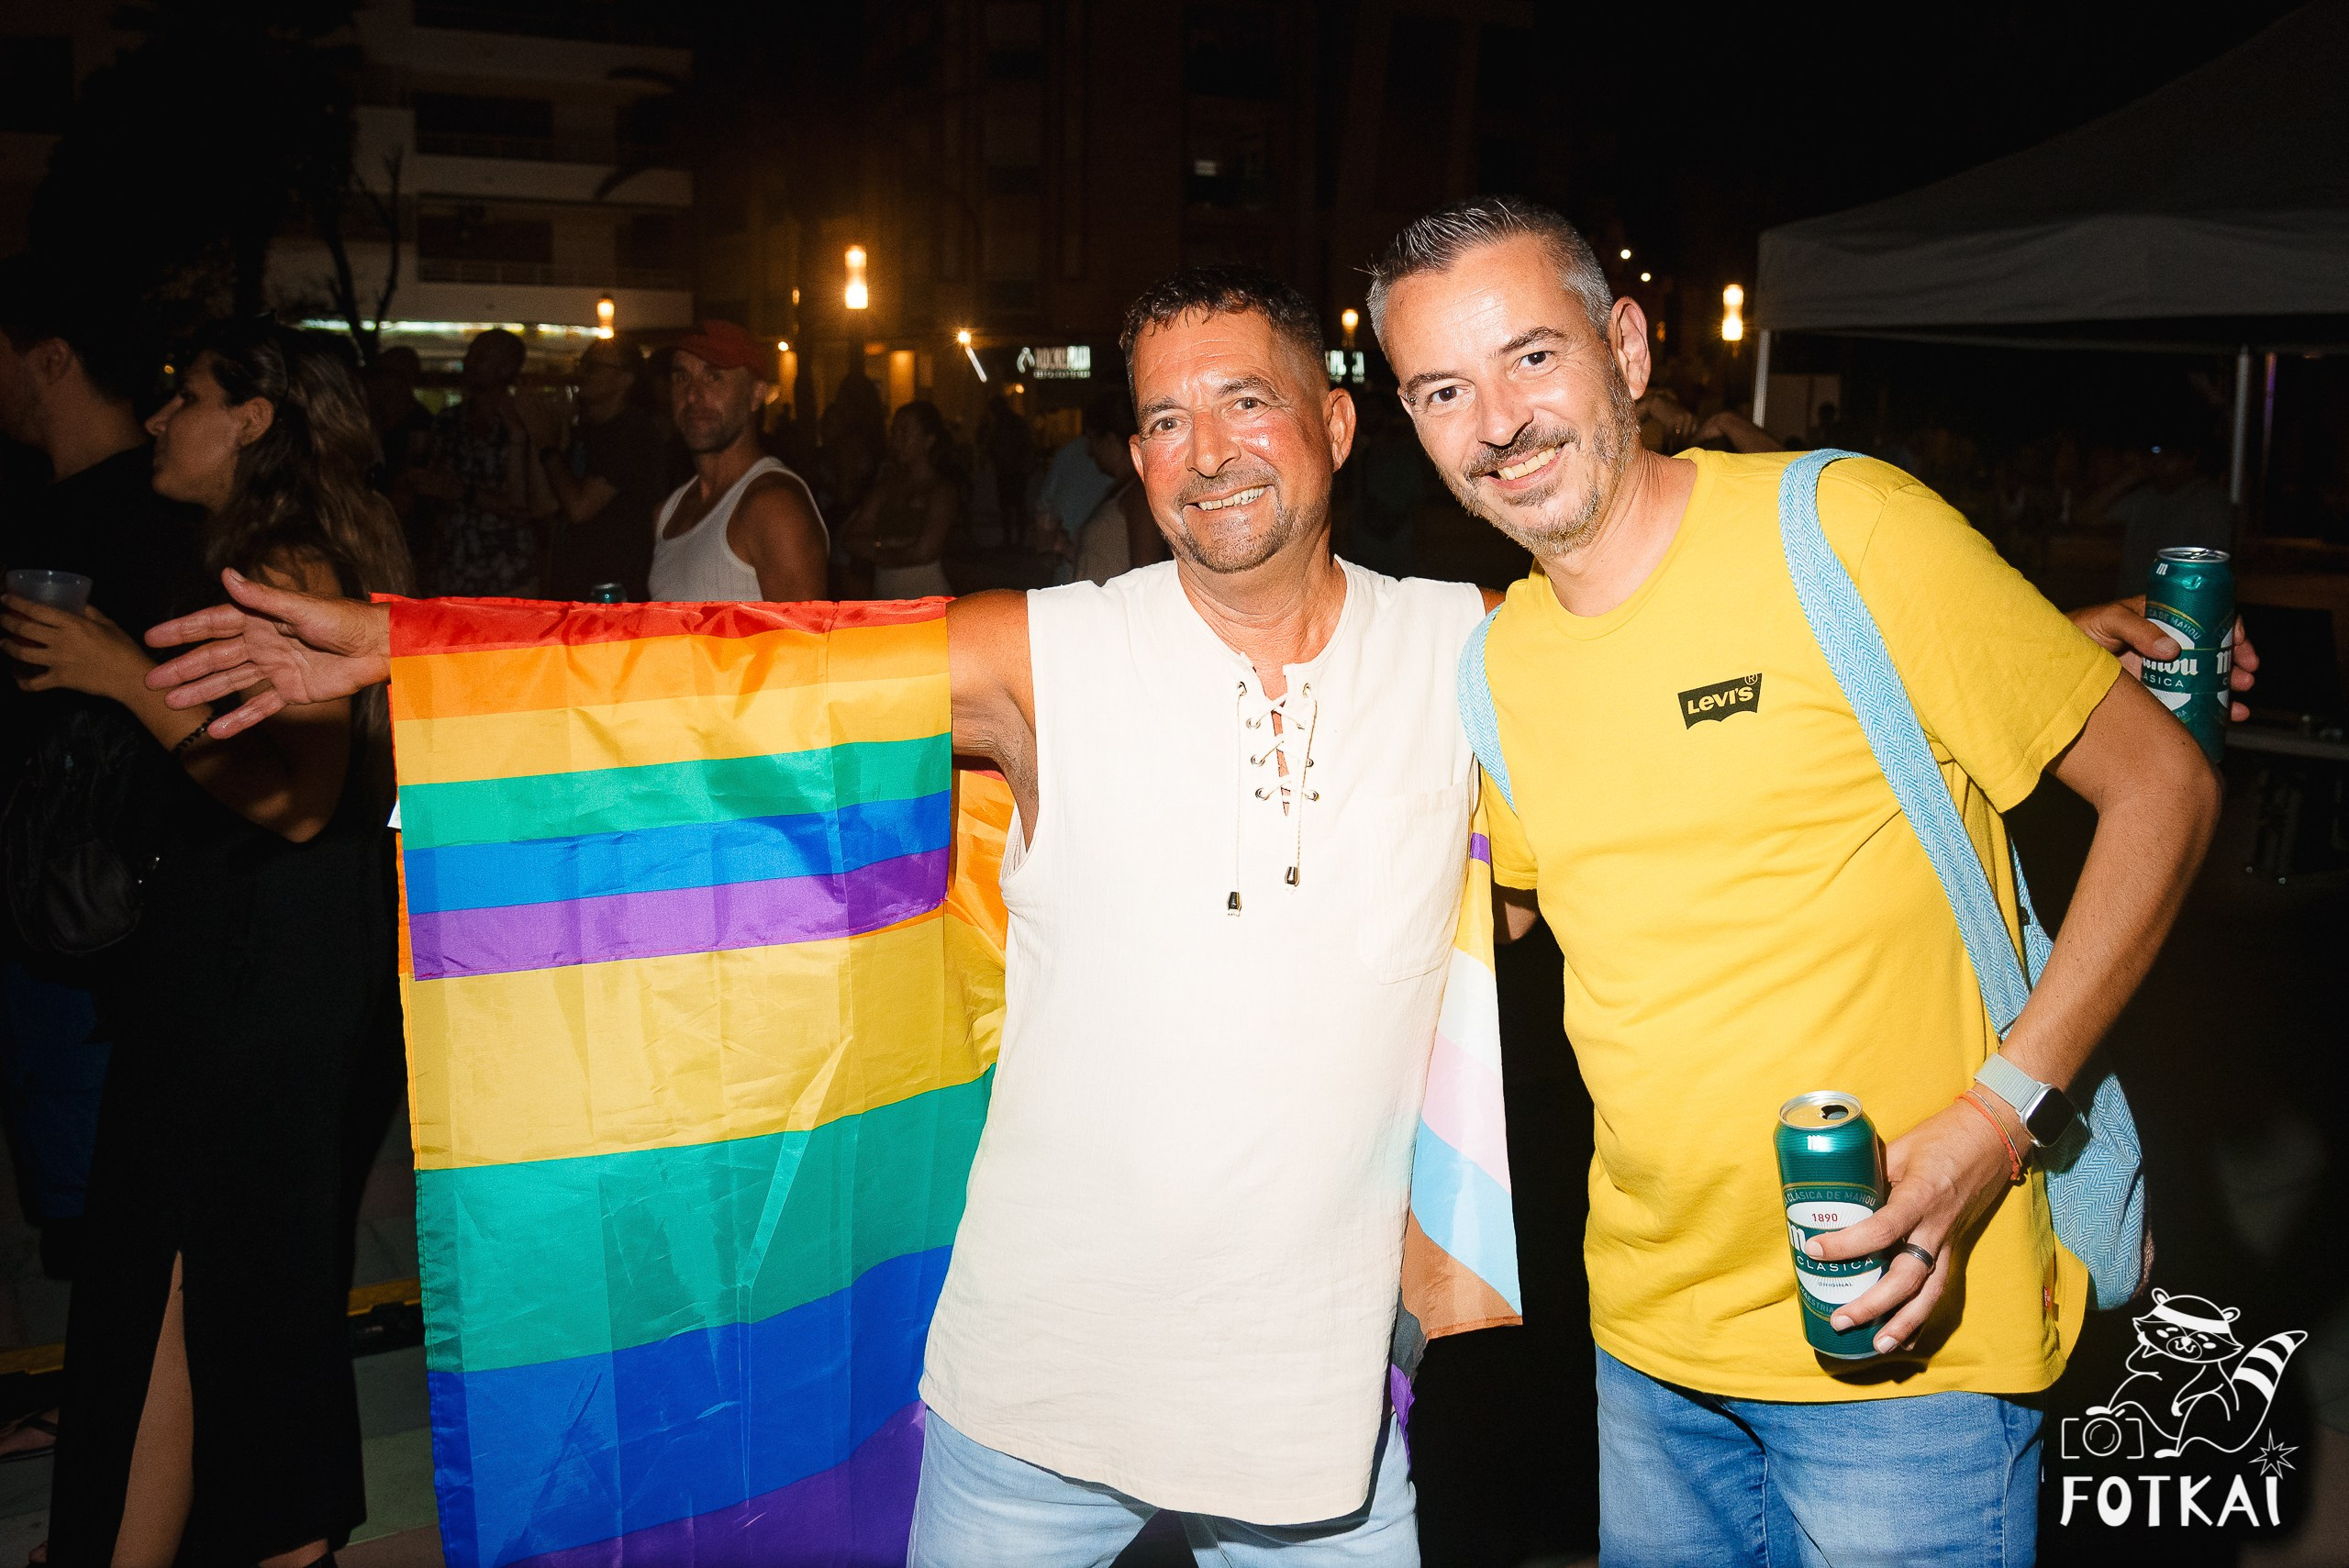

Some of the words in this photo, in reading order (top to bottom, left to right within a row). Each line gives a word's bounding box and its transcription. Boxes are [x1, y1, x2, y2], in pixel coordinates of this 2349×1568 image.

[2170, 616, 2201, 639] MAHOU
[1826, 1191, 1841, 1200] DE
[1844, 1193, 1876, 1207] MAHOU
[1811, 1213, 1838, 1222] 1890
[1797, 1255, 1874, 1272] CLASICA
